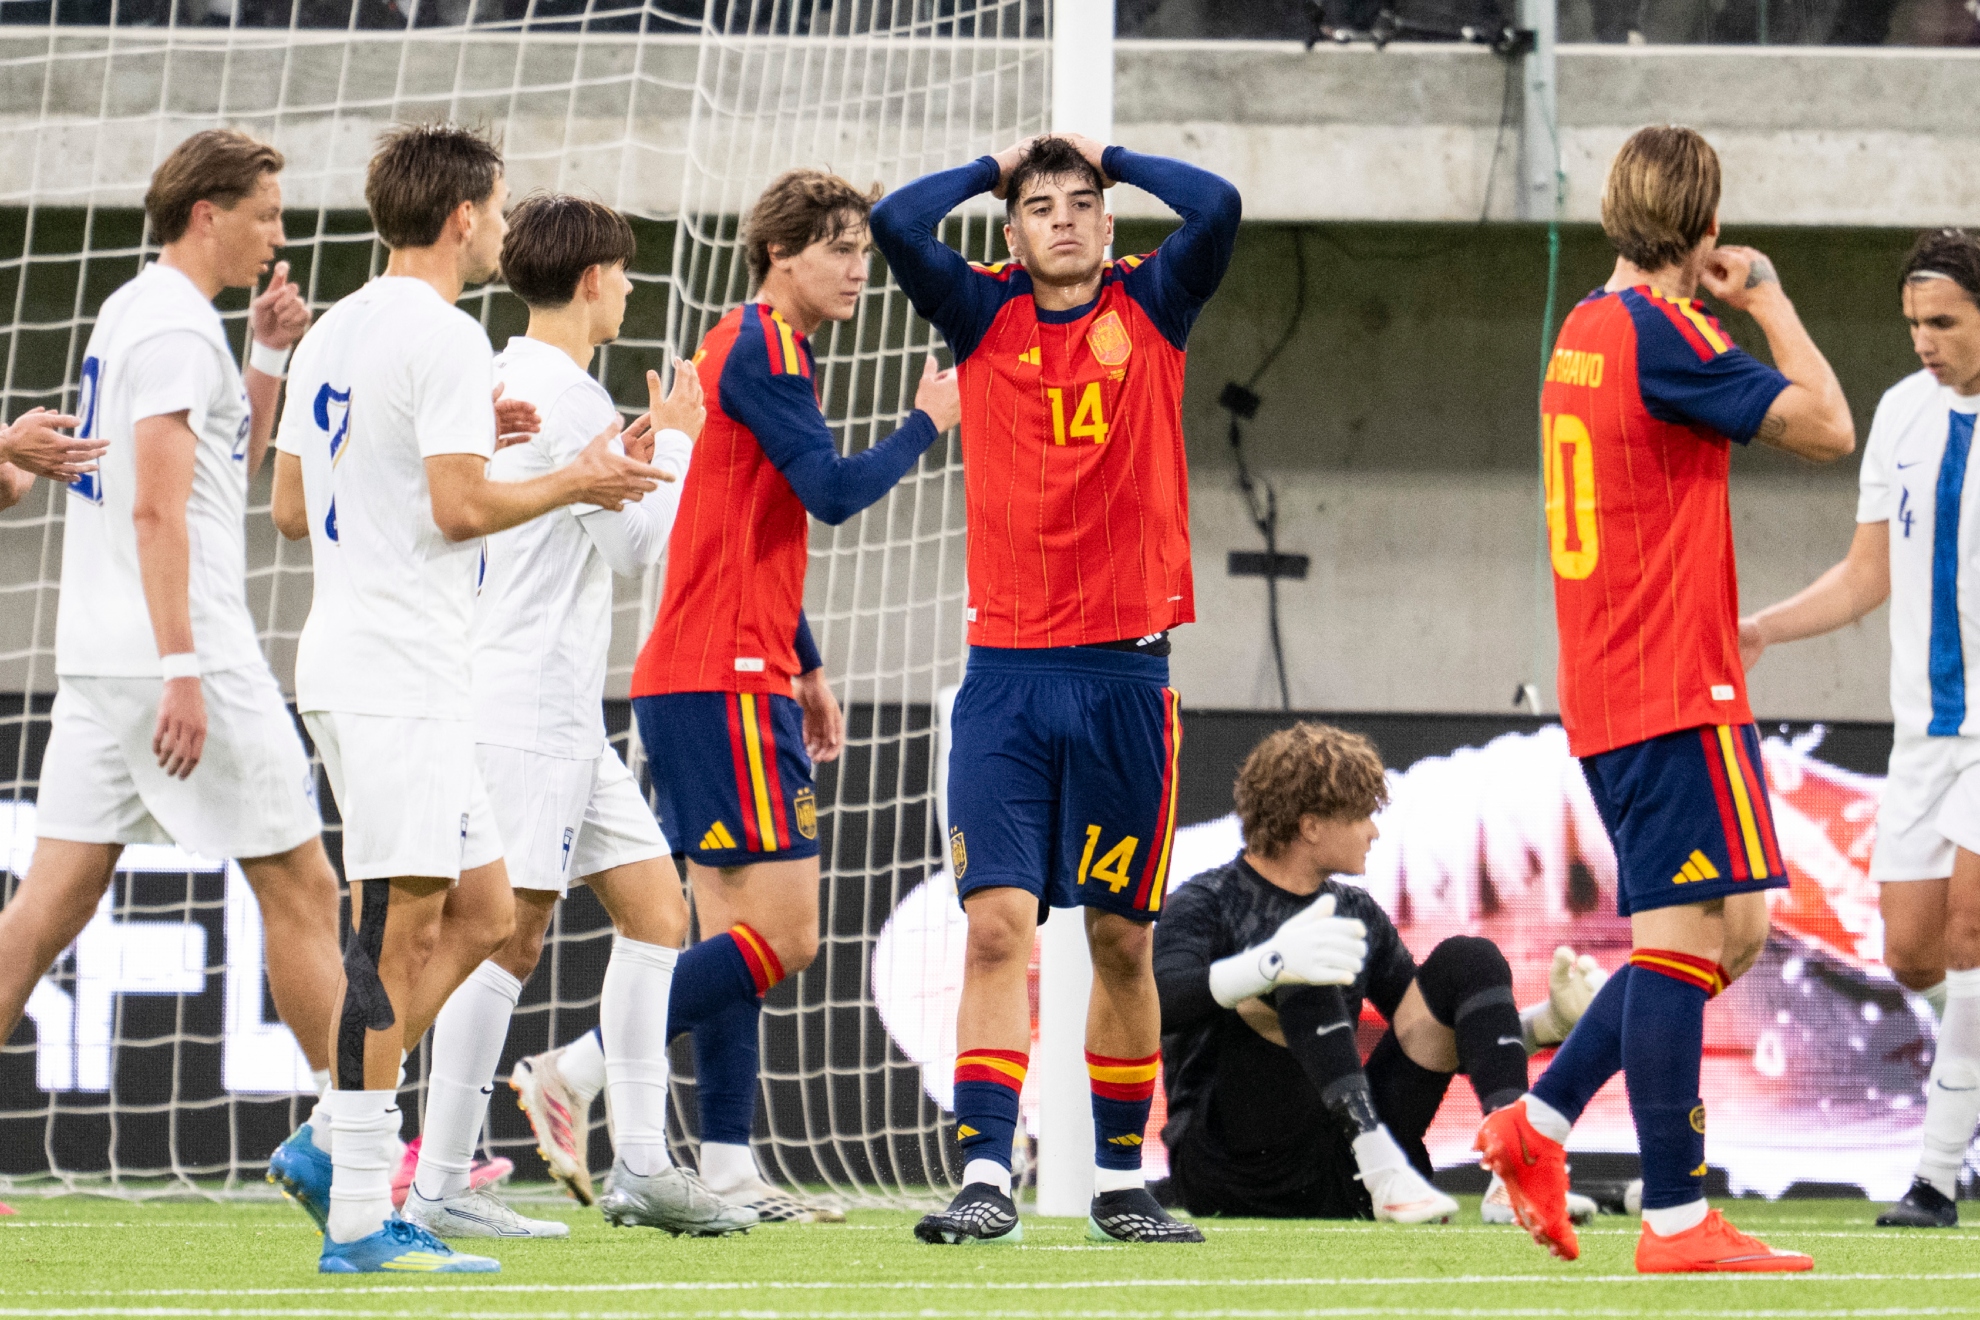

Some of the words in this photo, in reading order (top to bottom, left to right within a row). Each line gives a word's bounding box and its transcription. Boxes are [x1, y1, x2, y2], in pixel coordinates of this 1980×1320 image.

[1047, 382, 1109, 446] 14
[313, 382, 354, 545] 7
[1898, 485, 1916, 538] 4
[1077, 824, 1139, 893] 14
